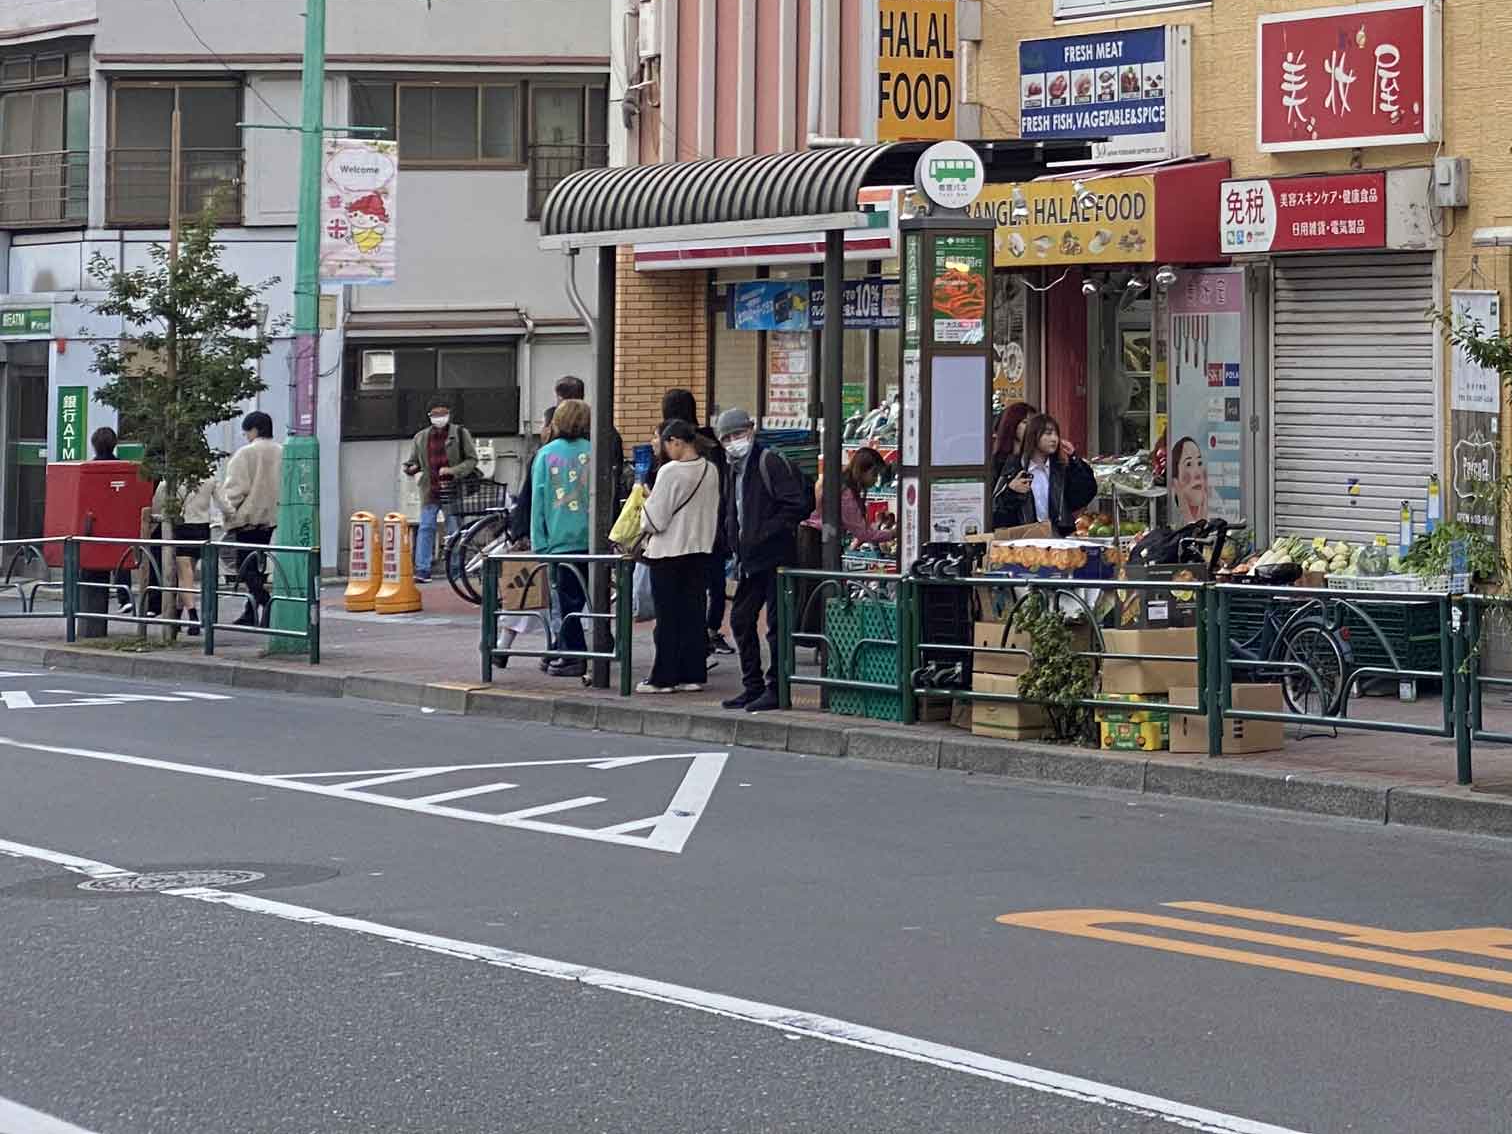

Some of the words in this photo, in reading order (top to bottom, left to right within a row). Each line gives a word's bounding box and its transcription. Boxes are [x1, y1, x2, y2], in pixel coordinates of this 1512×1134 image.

[878, 11, 954, 61] HALAL
[1064, 42, 1094, 62] FRESH
[1095, 40, 1124, 60] MEAT
[878, 72, 952, 122] FOOD
[1021, 113, 1050, 134] FRESH
[340, 165, 380, 175] Welcome
[1095, 192, 1147, 223] FOOD
[1226, 187, 1267, 226] 免税
[1279, 187, 1379, 208] 美容スキンケア・健康食品
[1291, 218, 1367, 237] 日用雑貨・電気製品
[62, 395, 78, 461] 銀行ATM
